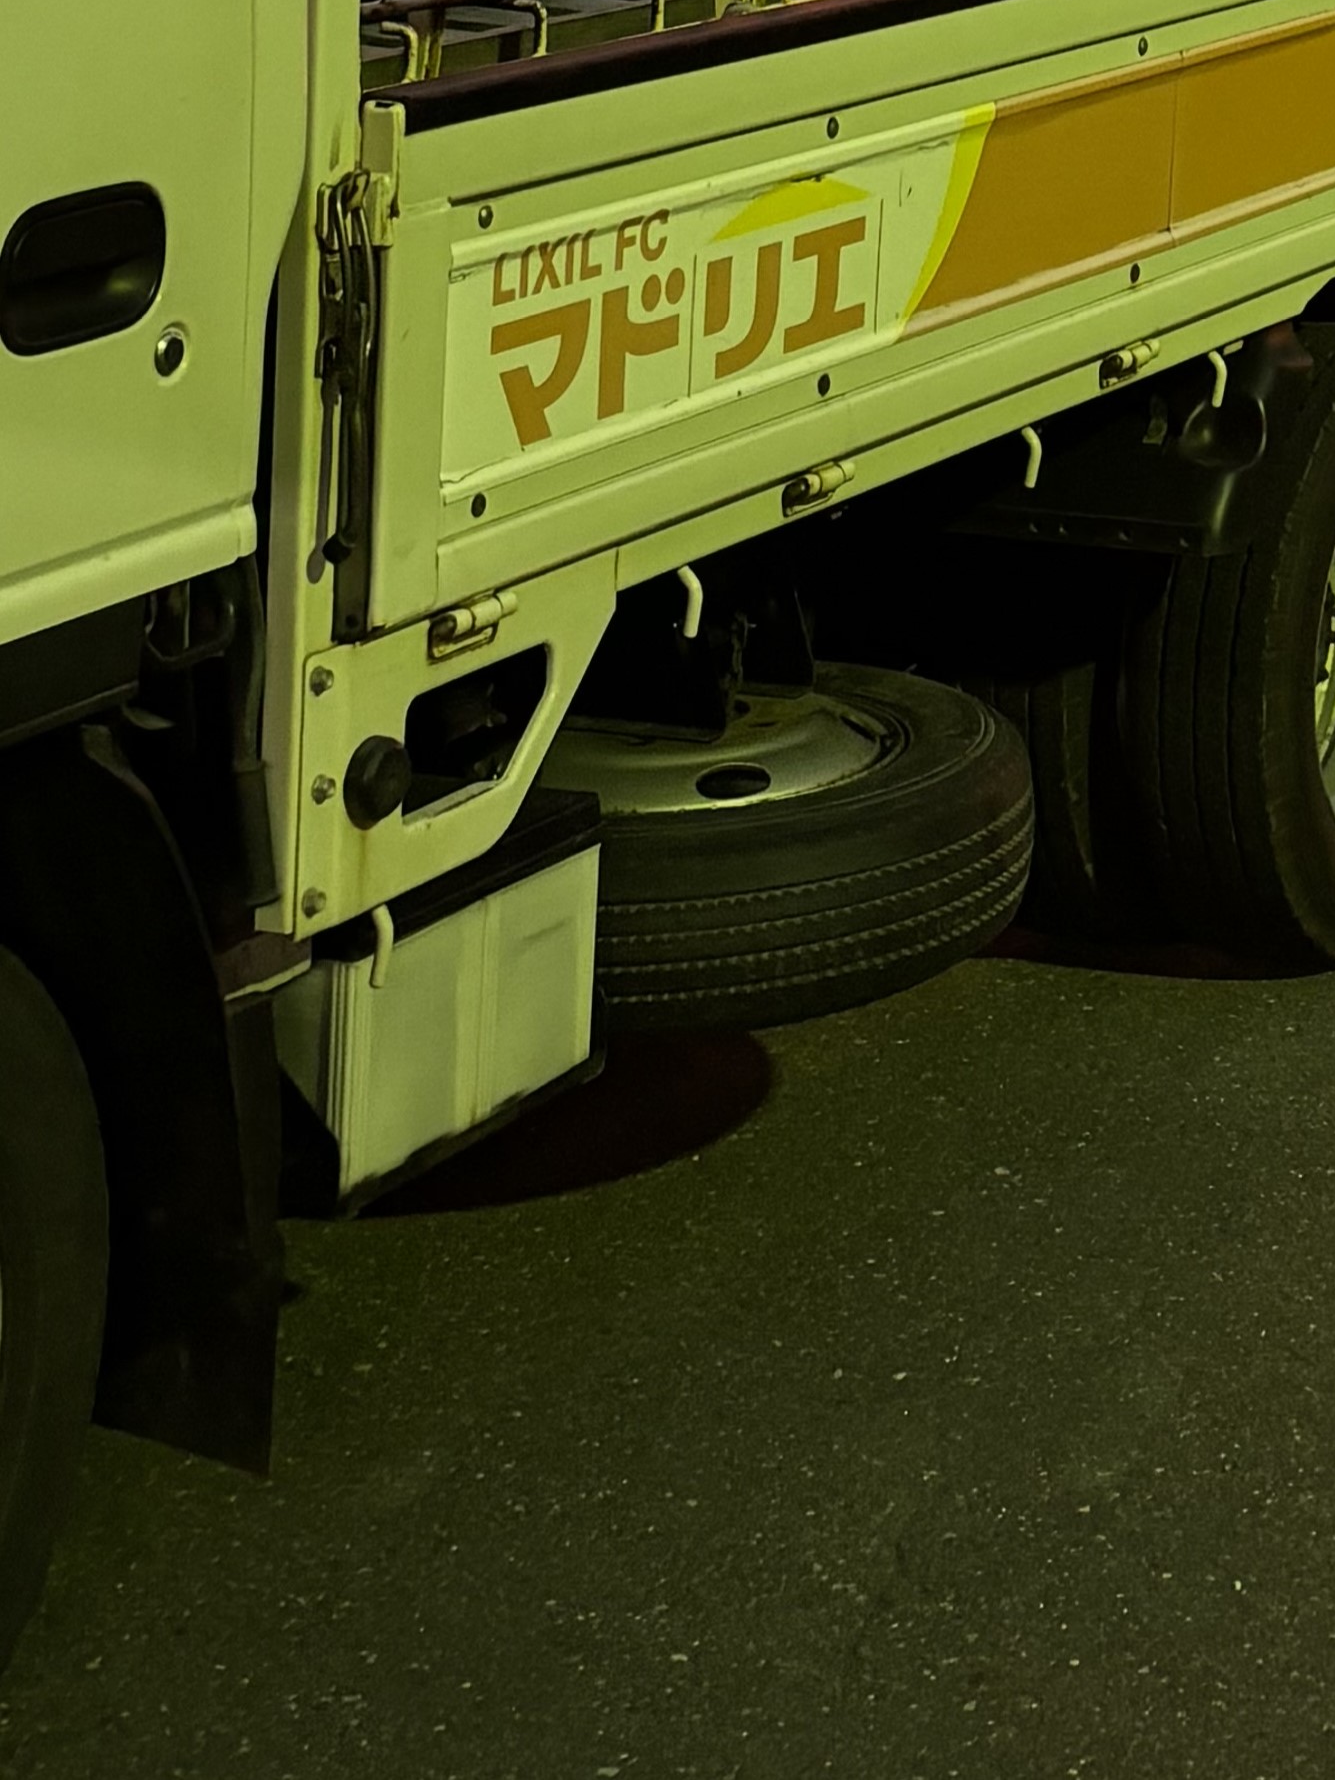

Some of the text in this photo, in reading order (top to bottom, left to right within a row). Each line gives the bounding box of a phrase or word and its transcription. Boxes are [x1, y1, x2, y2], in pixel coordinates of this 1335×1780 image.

[489, 215, 867, 448] マドリエ
[491, 208, 671, 308] LIXIL FC
